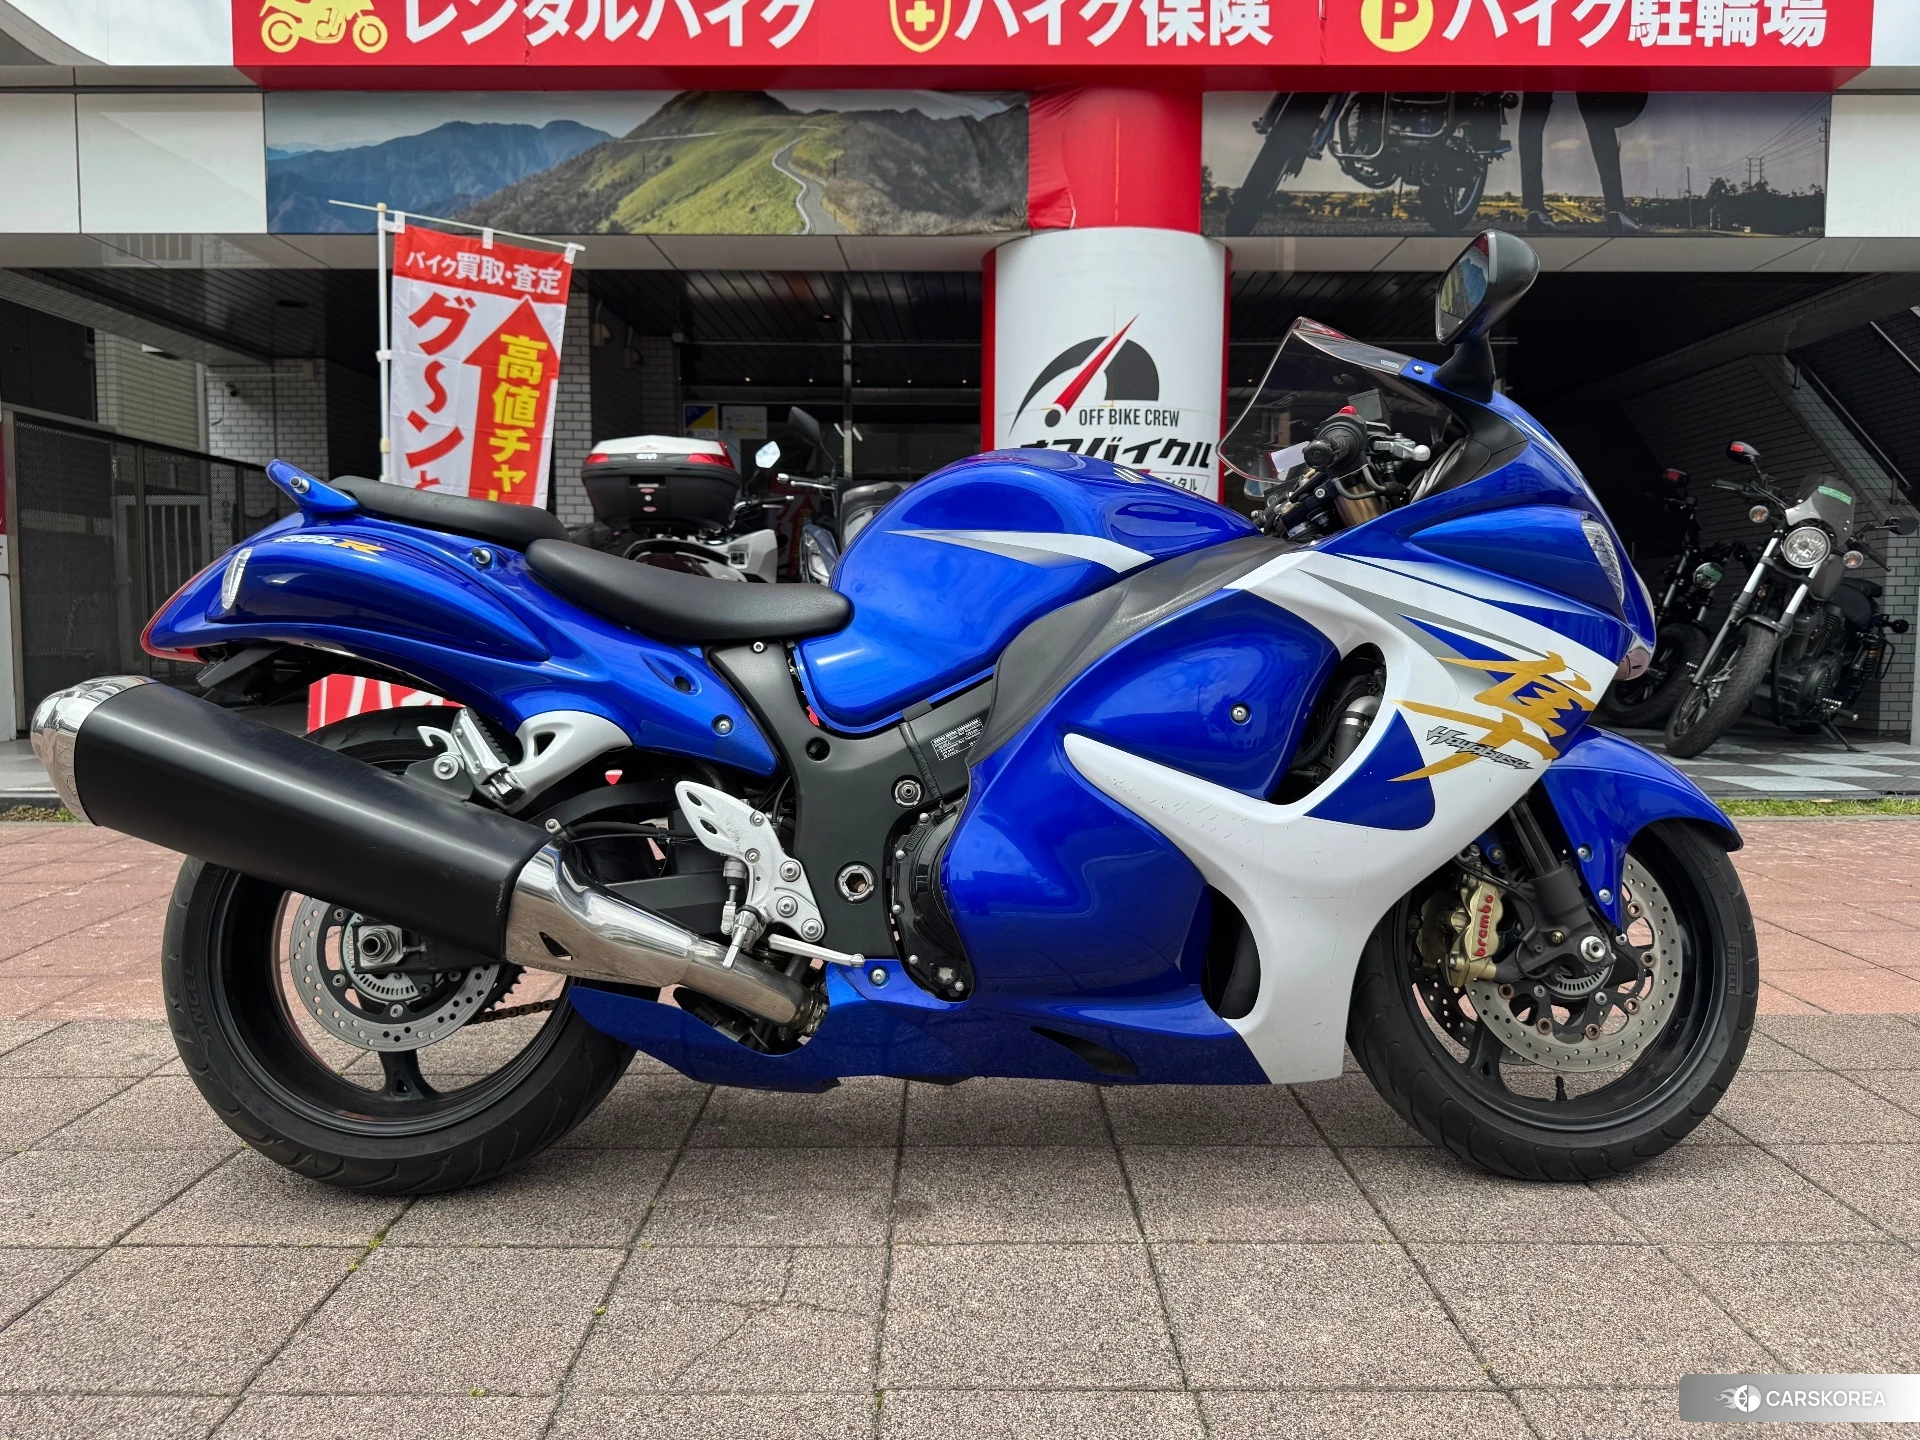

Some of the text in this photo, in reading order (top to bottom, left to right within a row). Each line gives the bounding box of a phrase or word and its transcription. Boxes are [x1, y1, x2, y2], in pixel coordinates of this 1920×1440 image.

[954, 0, 1274, 47] バイク保険
[405, 251, 562, 296] バイク買取・査定
[488, 334, 548, 504] 高値チャ
[1079, 408, 1180, 427] OFF BIKE CREW
[1473, 894, 1494, 957] brembo
